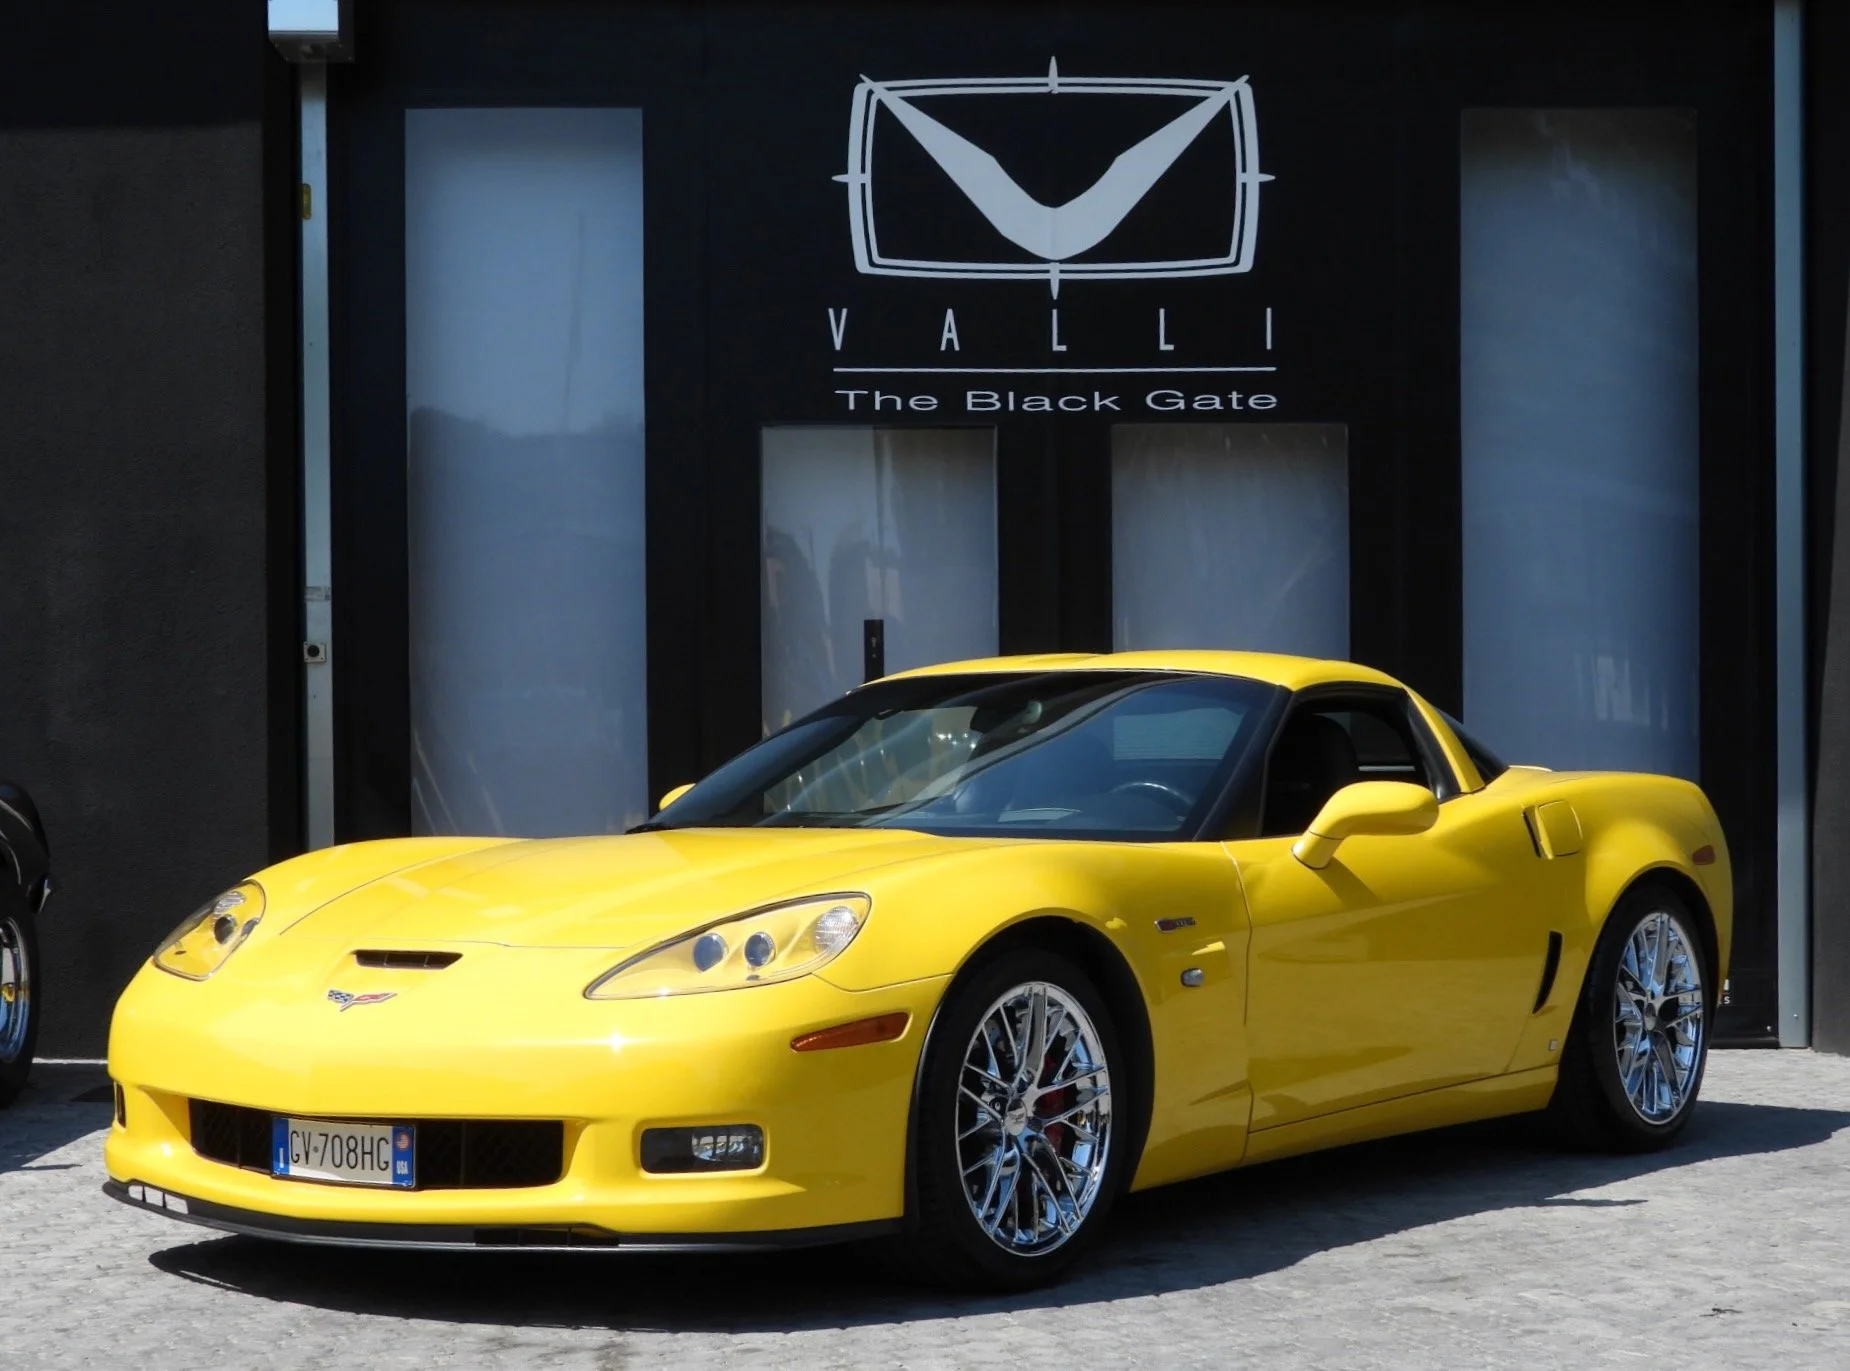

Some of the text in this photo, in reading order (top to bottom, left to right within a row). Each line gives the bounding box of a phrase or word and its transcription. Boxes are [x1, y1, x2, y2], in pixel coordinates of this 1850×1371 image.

[828, 307, 1273, 351] VALLI
[834, 389, 1279, 412] The Black Gate
[396, 1160, 409, 1175] USA
